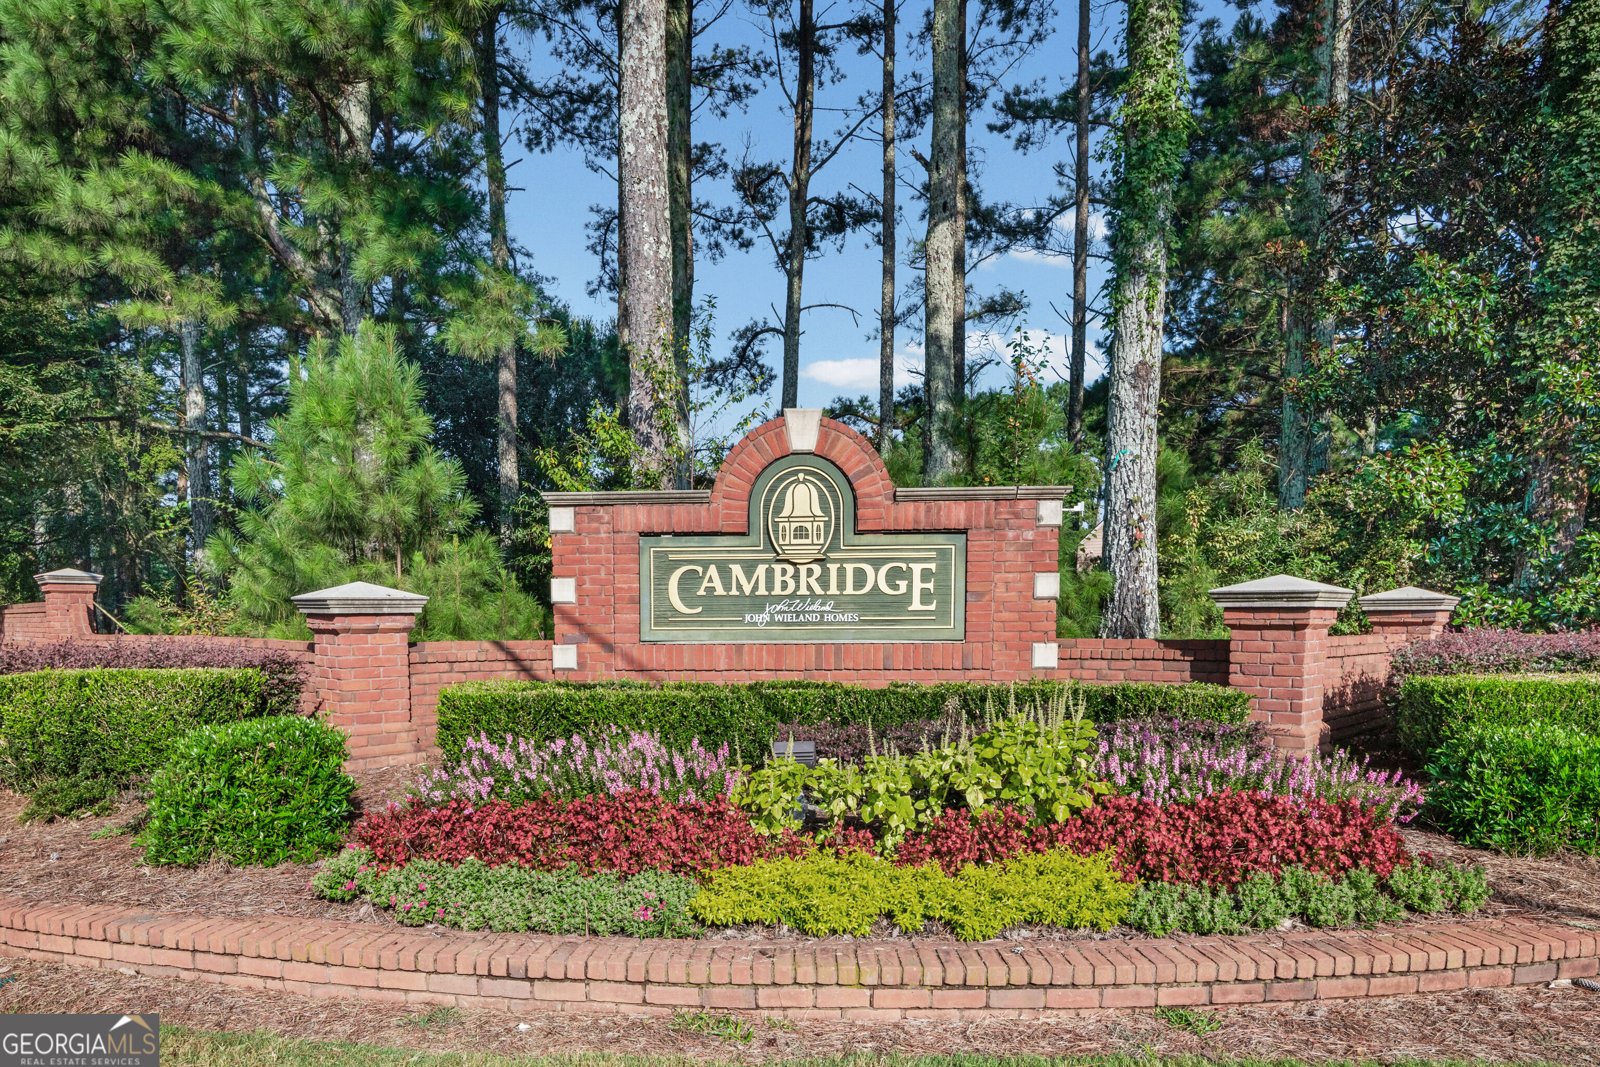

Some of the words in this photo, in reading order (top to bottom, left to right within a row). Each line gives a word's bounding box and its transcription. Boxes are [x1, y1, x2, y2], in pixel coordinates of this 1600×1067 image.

[668, 562, 937, 614] CAMBRIDGE
[745, 613, 770, 623] JOHN
[774, 613, 820, 622] WIELAND
[824, 613, 859, 622] HOMES
